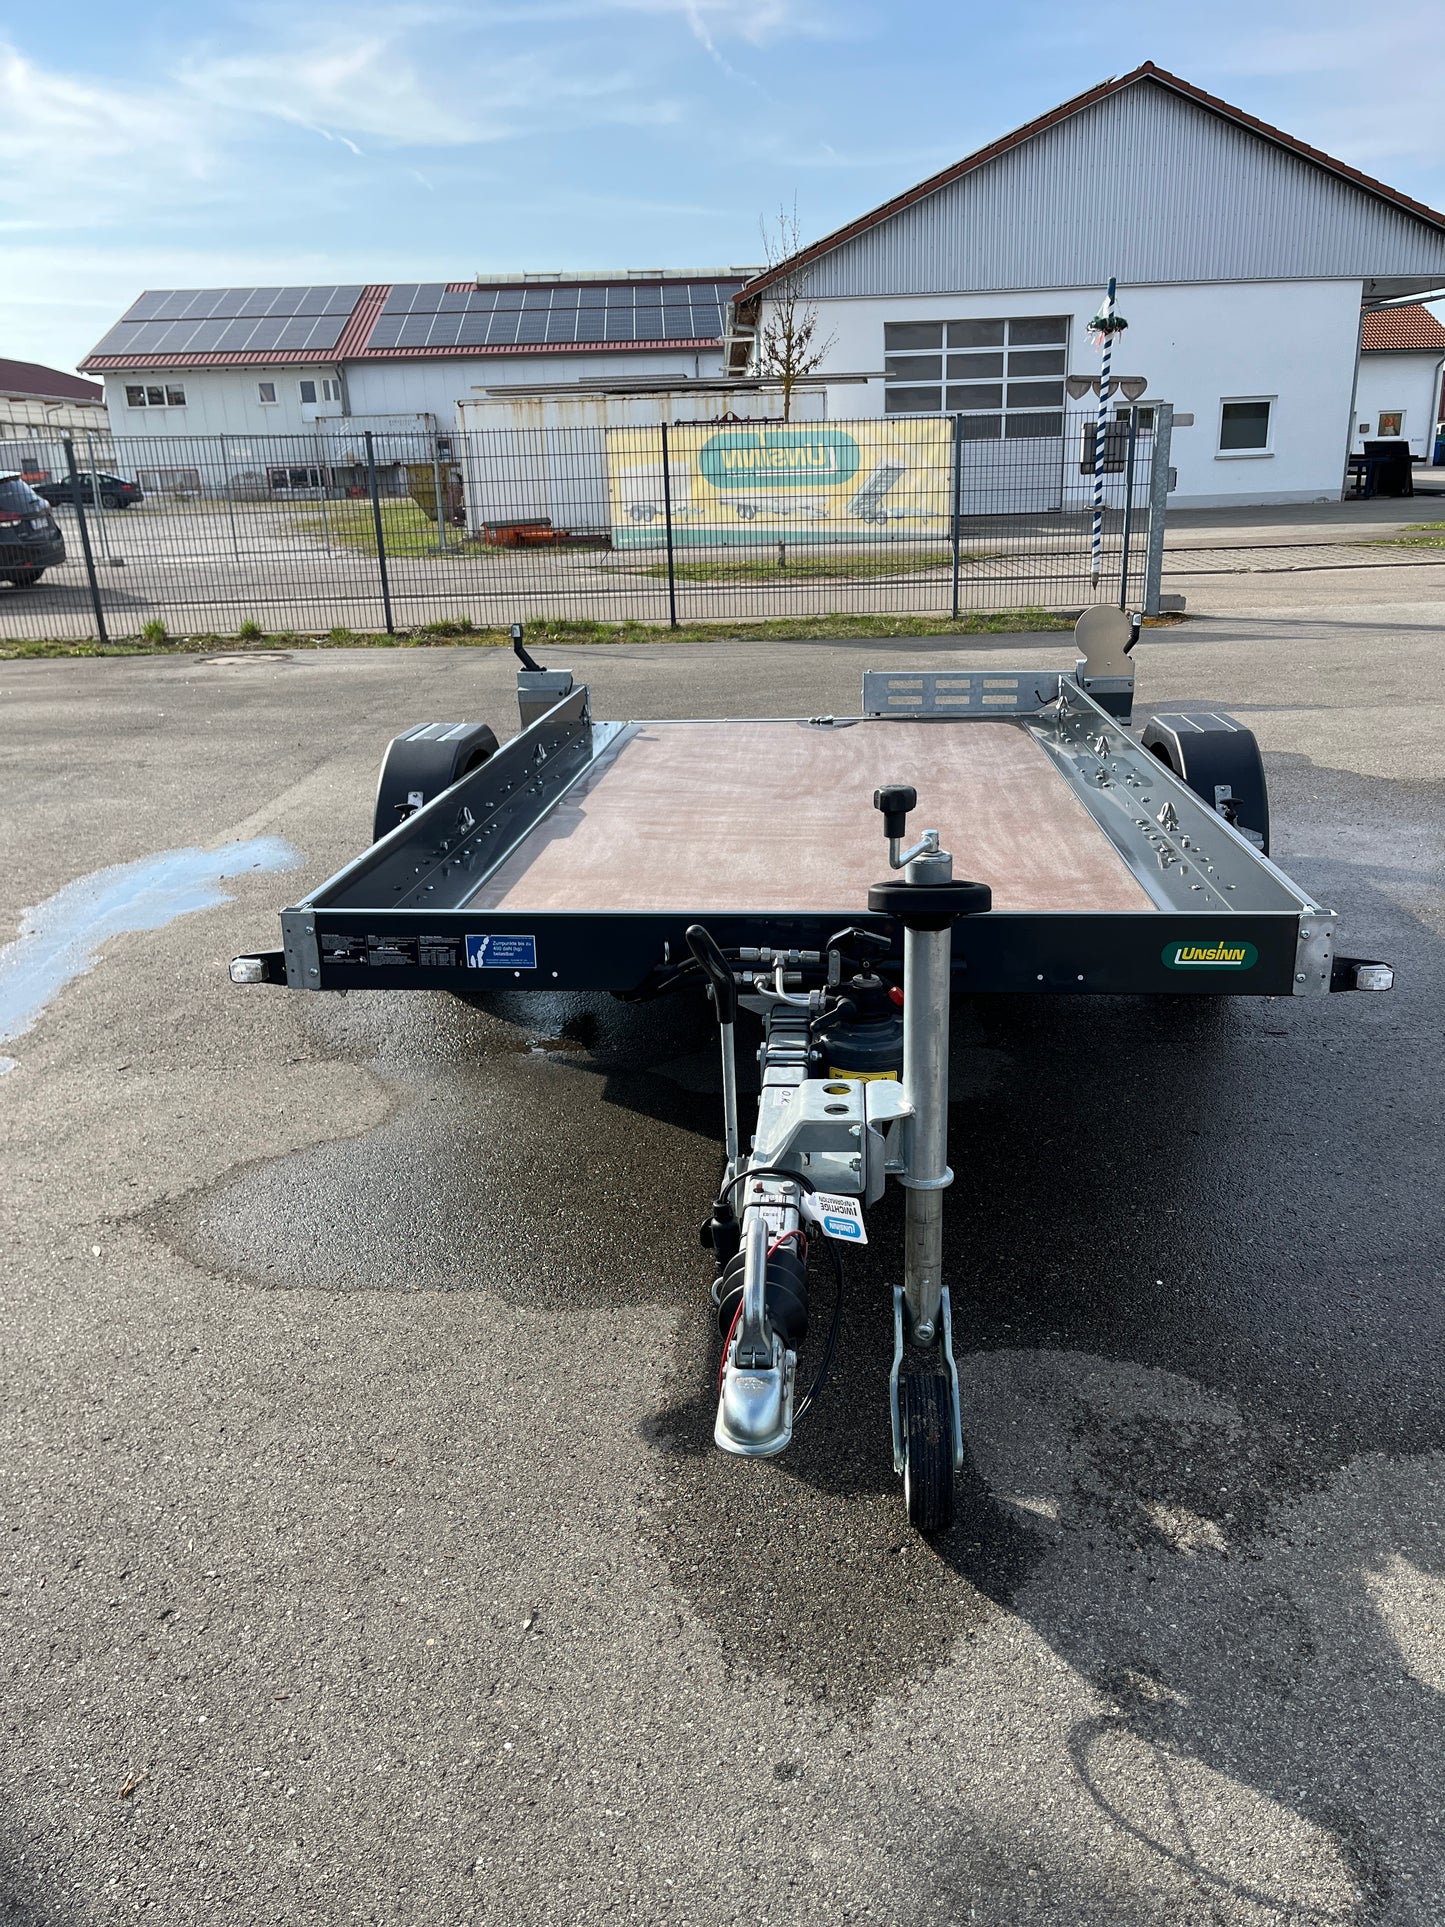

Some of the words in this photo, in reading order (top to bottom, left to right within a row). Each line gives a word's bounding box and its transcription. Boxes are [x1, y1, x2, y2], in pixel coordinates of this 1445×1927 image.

[1181, 941, 1246, 961] UNSINN
[818, 1195, 852, 1206] INFORMATION
[820, 1203, 854, 1216] WICHTIGE
